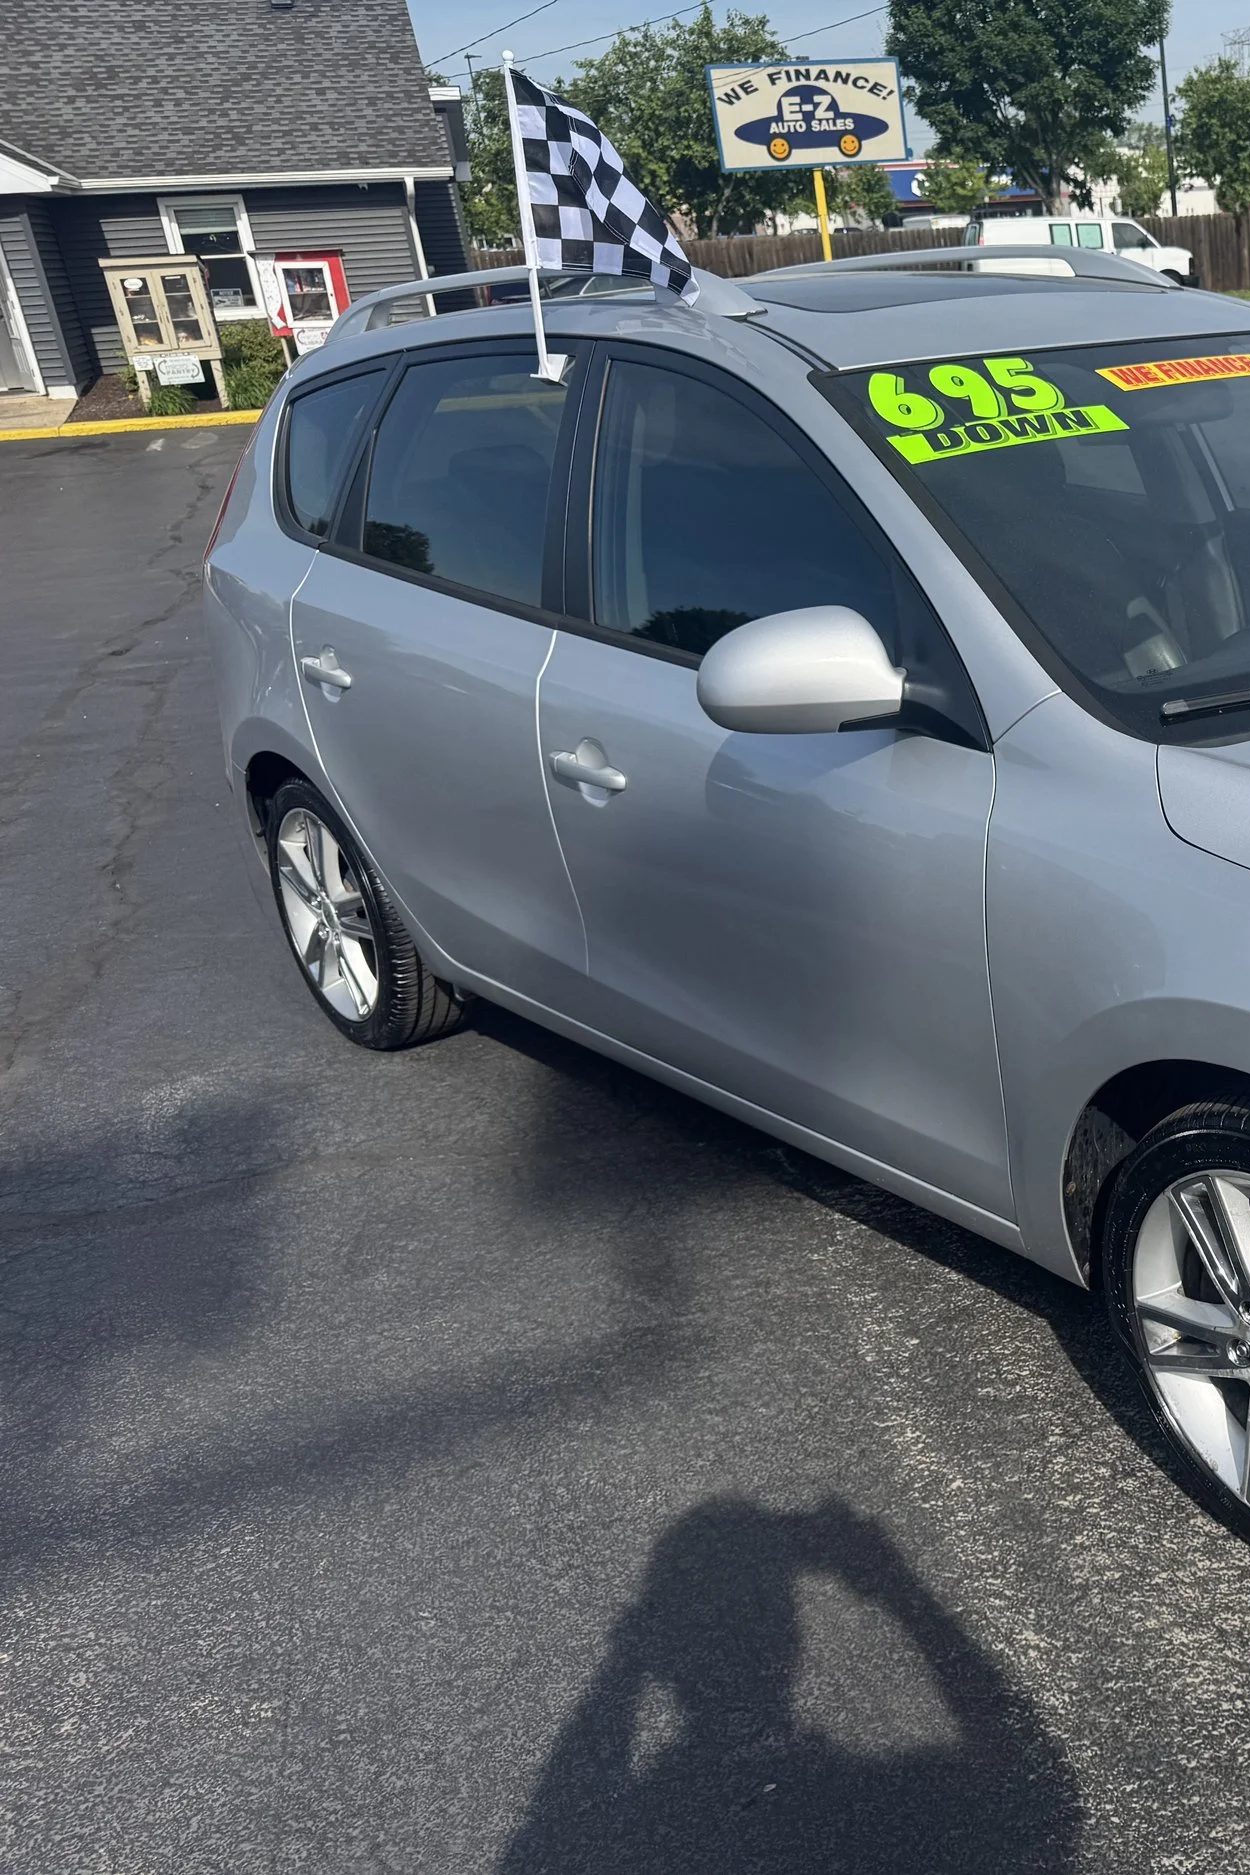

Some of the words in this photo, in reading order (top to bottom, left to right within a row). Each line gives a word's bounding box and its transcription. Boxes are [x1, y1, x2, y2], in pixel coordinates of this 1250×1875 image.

[717, 80, 759, 106] WE
[767, 68, 895, 100] FINANCE!
[780, 95, 835, 121] E-Z
[770, 121, 806, 134] AUTO
[811, 118, 855, 131] SALES
[1108, 366, 1160, 386] WE
[868, 357, 1065, 431] 695
[920, 410, 1100, 454] DOWN
